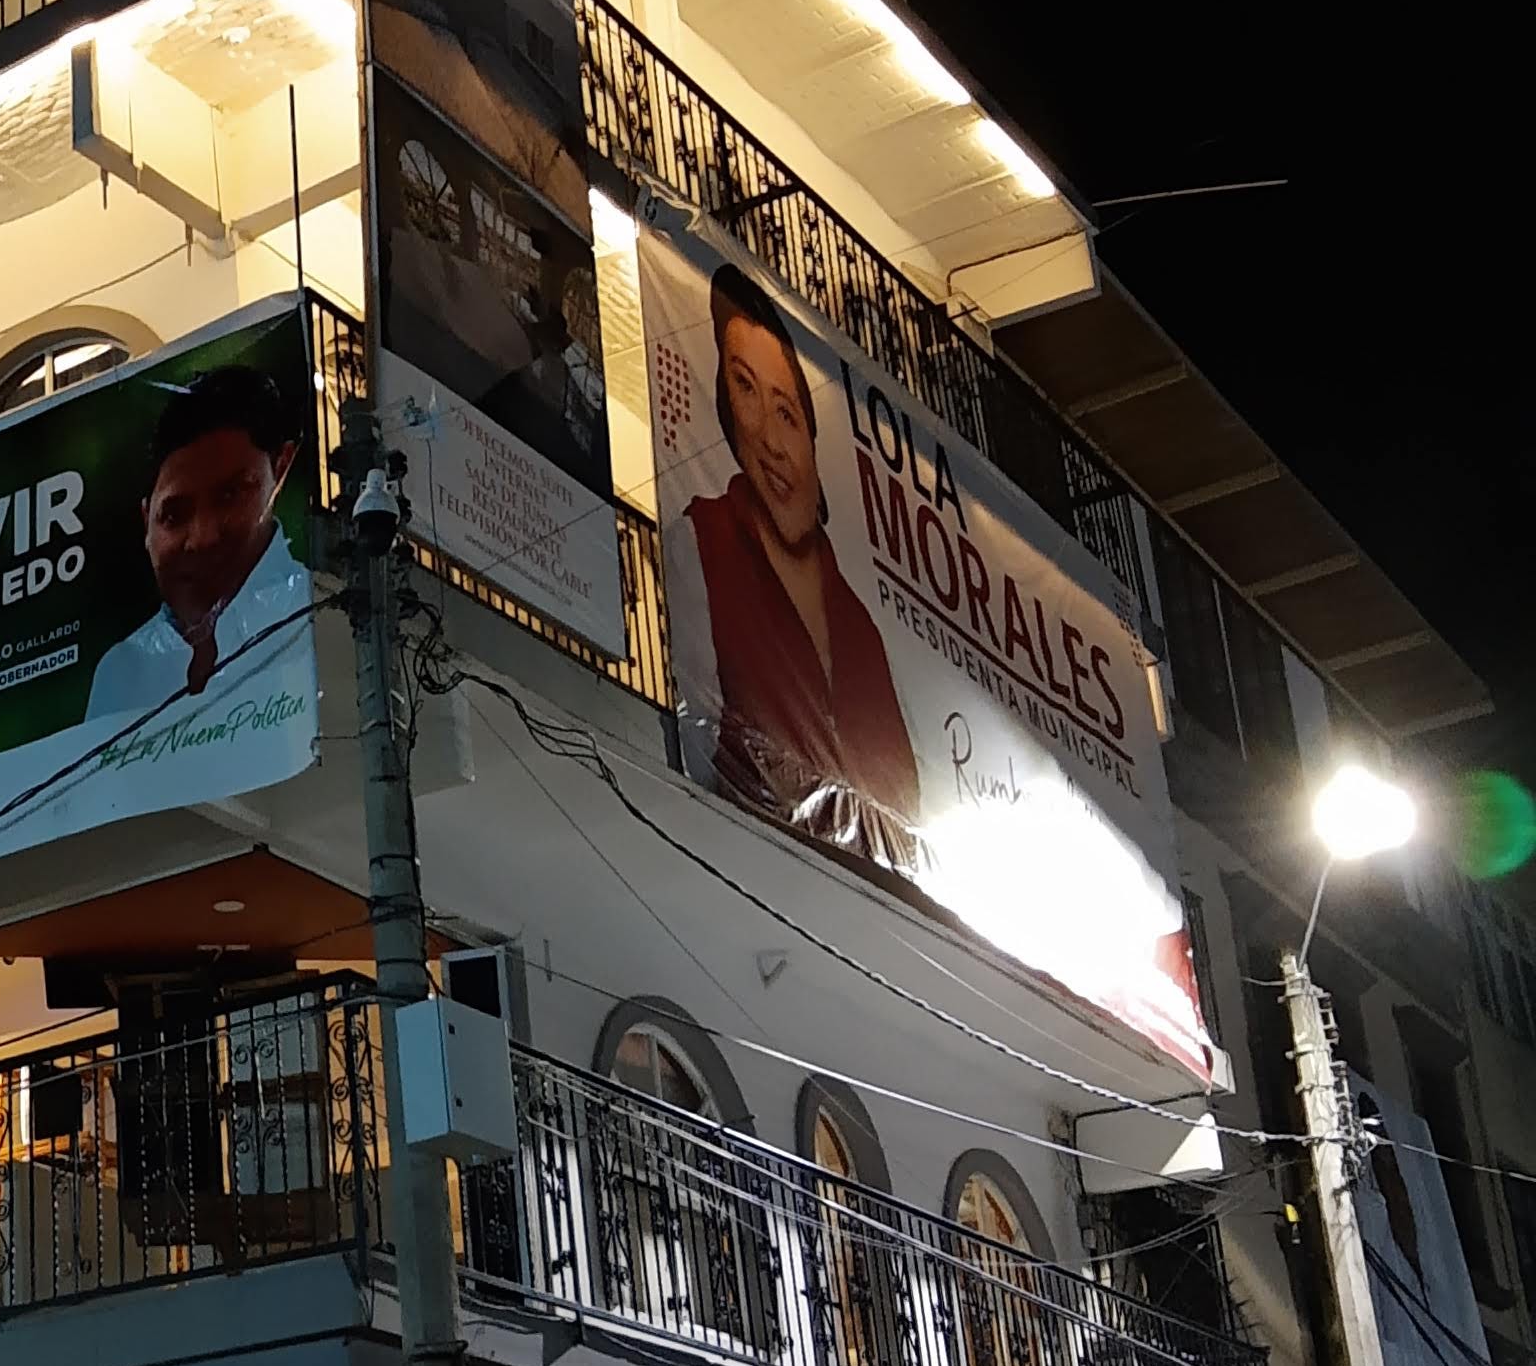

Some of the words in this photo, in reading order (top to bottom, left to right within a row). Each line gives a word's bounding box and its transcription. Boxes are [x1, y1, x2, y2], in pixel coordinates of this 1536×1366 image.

[839, 358, 968, 534] LOLA
[15, 619, 82, 654] GALLARDO
[856, 446, 1125, 741] MORALES
[877, 577, 1022, 717] PRESIDENTA
[1027, 695, 1142, 801] MUNICIPAL
